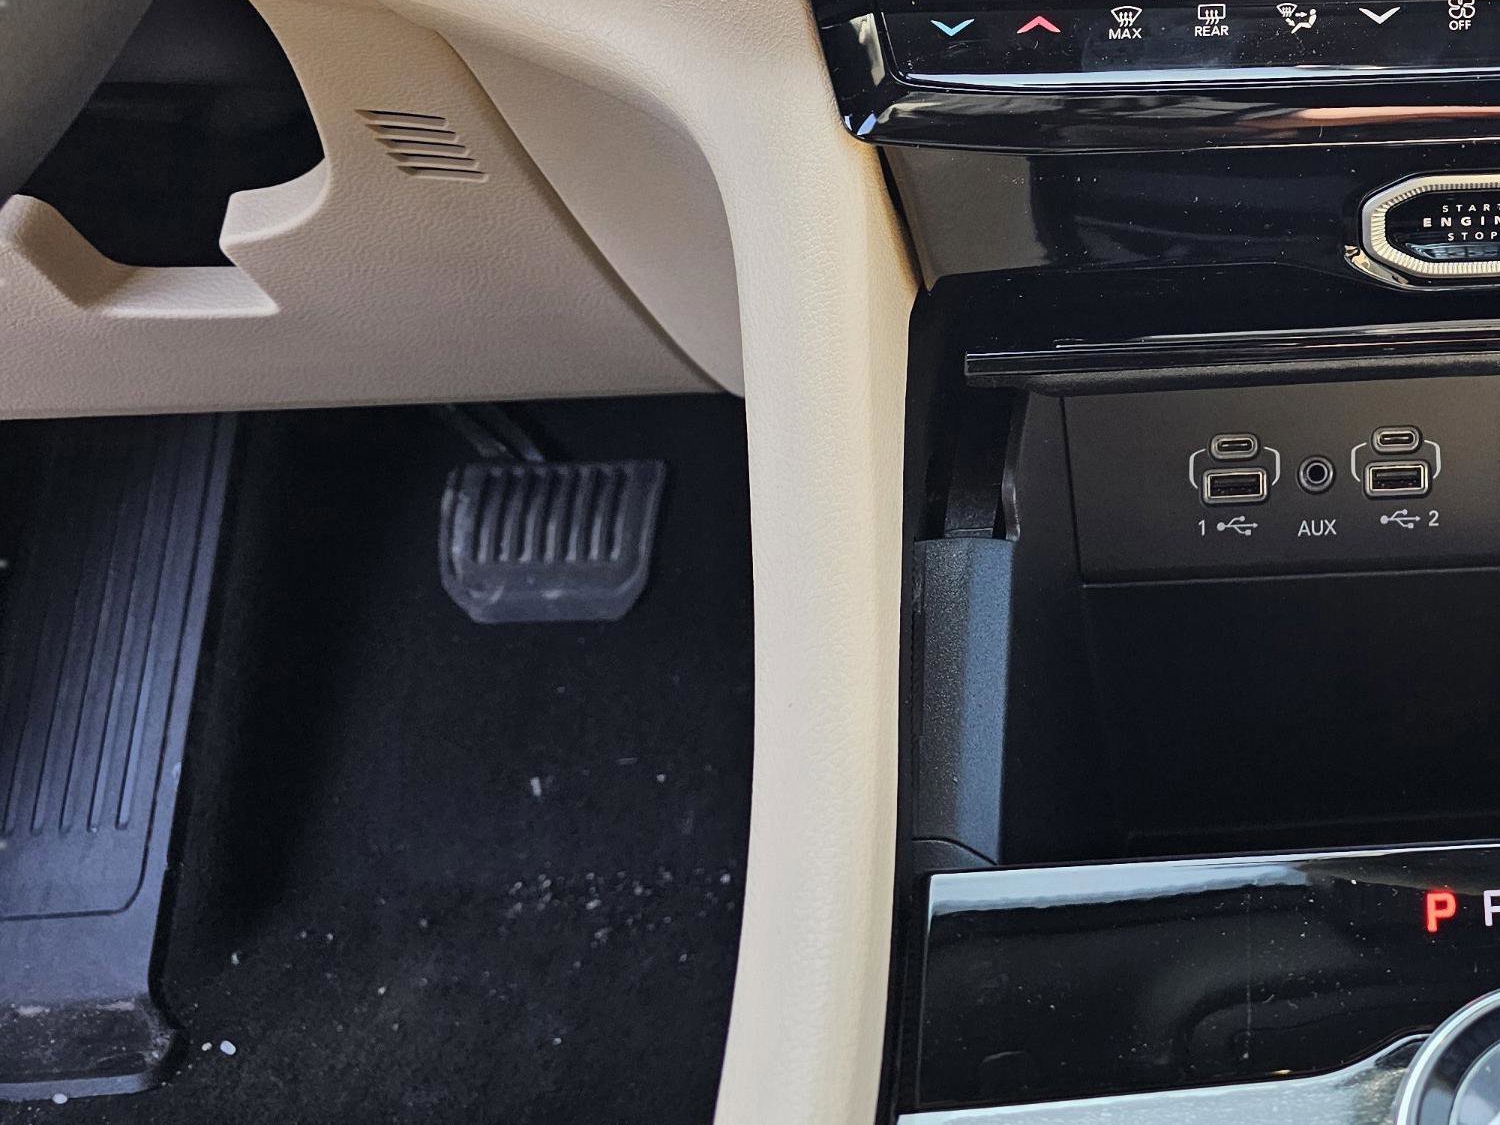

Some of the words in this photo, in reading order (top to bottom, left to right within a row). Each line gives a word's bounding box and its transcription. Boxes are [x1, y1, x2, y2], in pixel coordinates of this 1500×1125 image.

[1194, 26, 1229, 36] REAR
[1449, 20, 1472, 31] OFF
[1108, 28, 1142, 40] MAX
[1447, 231, 1498, 241] STOP
[1428, 511, 1439, 526] 2
[1199, 521, 1206, 535] 1
[1297, 520, 1337, 536] AUX
[1425, 891, 1457, 932] P
